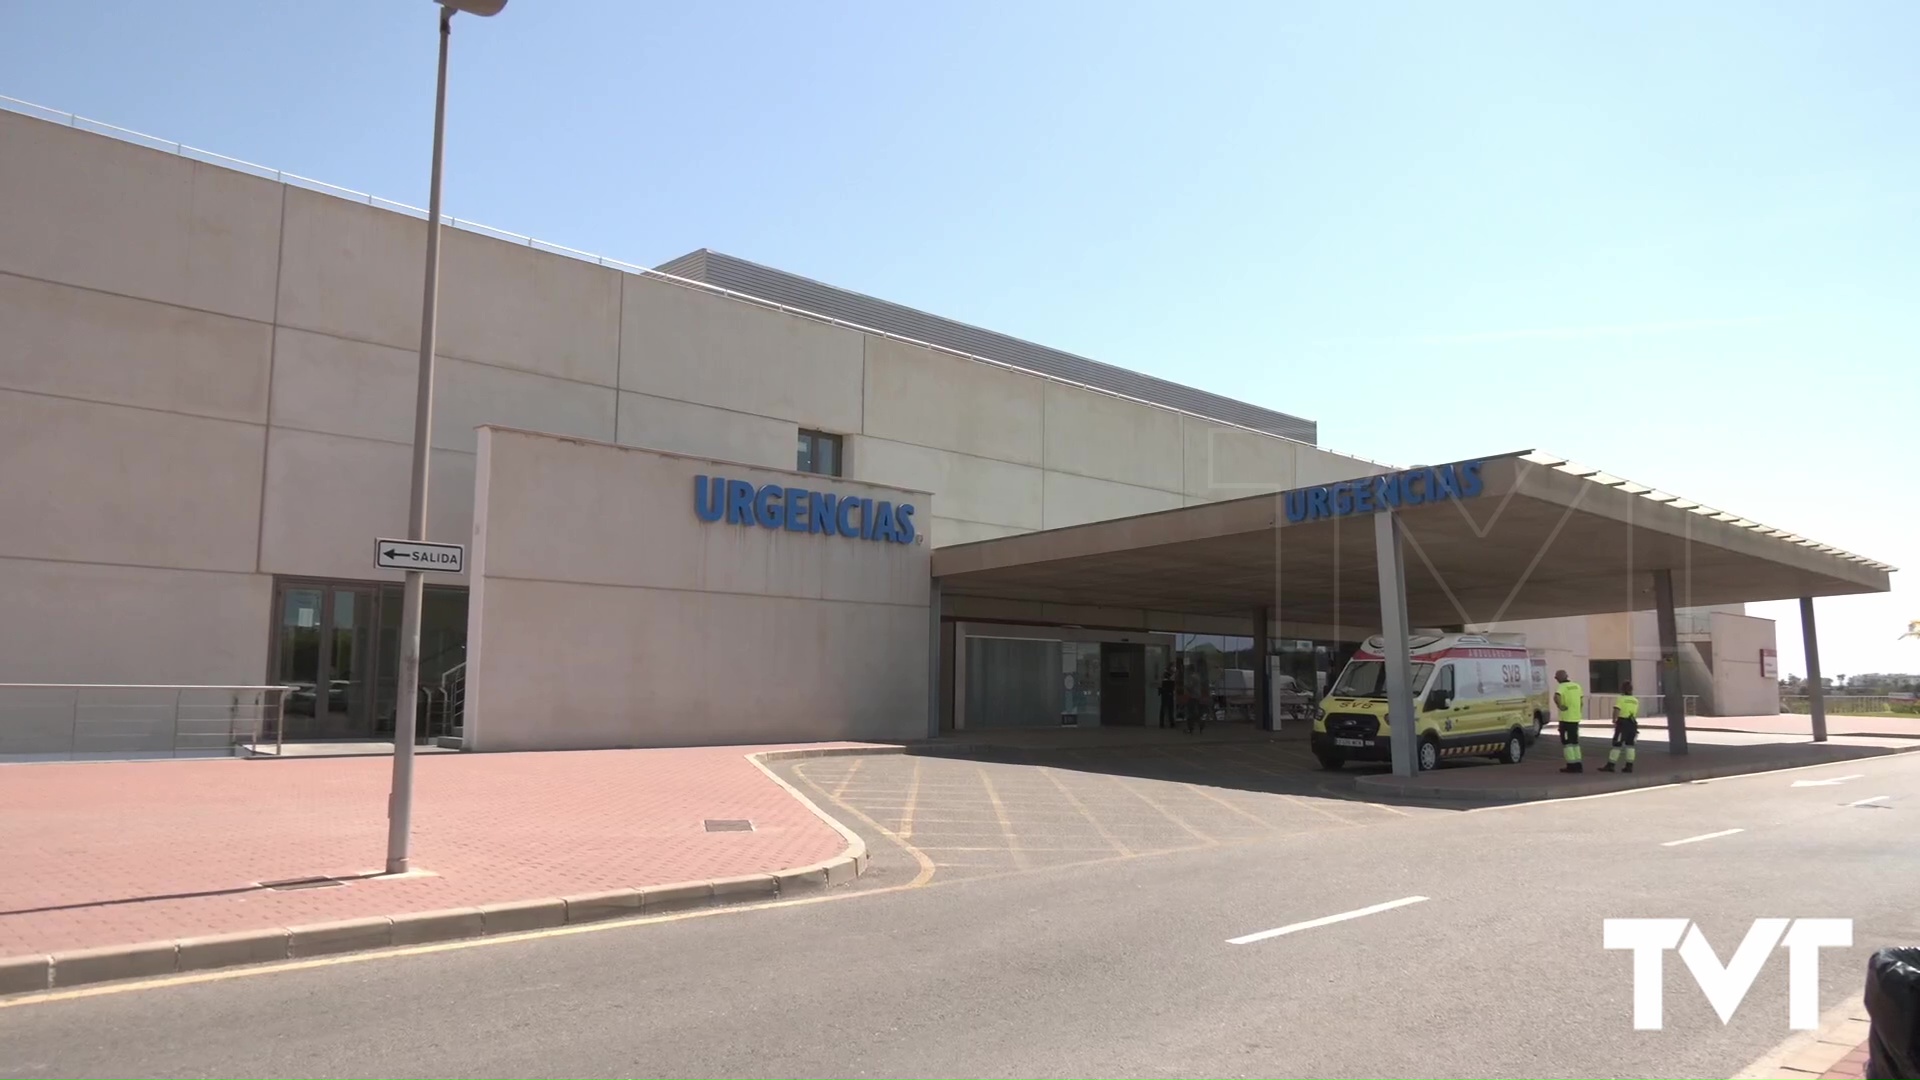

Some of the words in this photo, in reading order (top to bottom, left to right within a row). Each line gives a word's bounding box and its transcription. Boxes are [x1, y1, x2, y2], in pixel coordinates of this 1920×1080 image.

[695, 475, 915, 544] URGENCIAS
[1286, 461, 1484, 523] URGENCIAS
[412, 551, 458, 564] SALIDA
[1502, 664, 1521, 682] SVB
